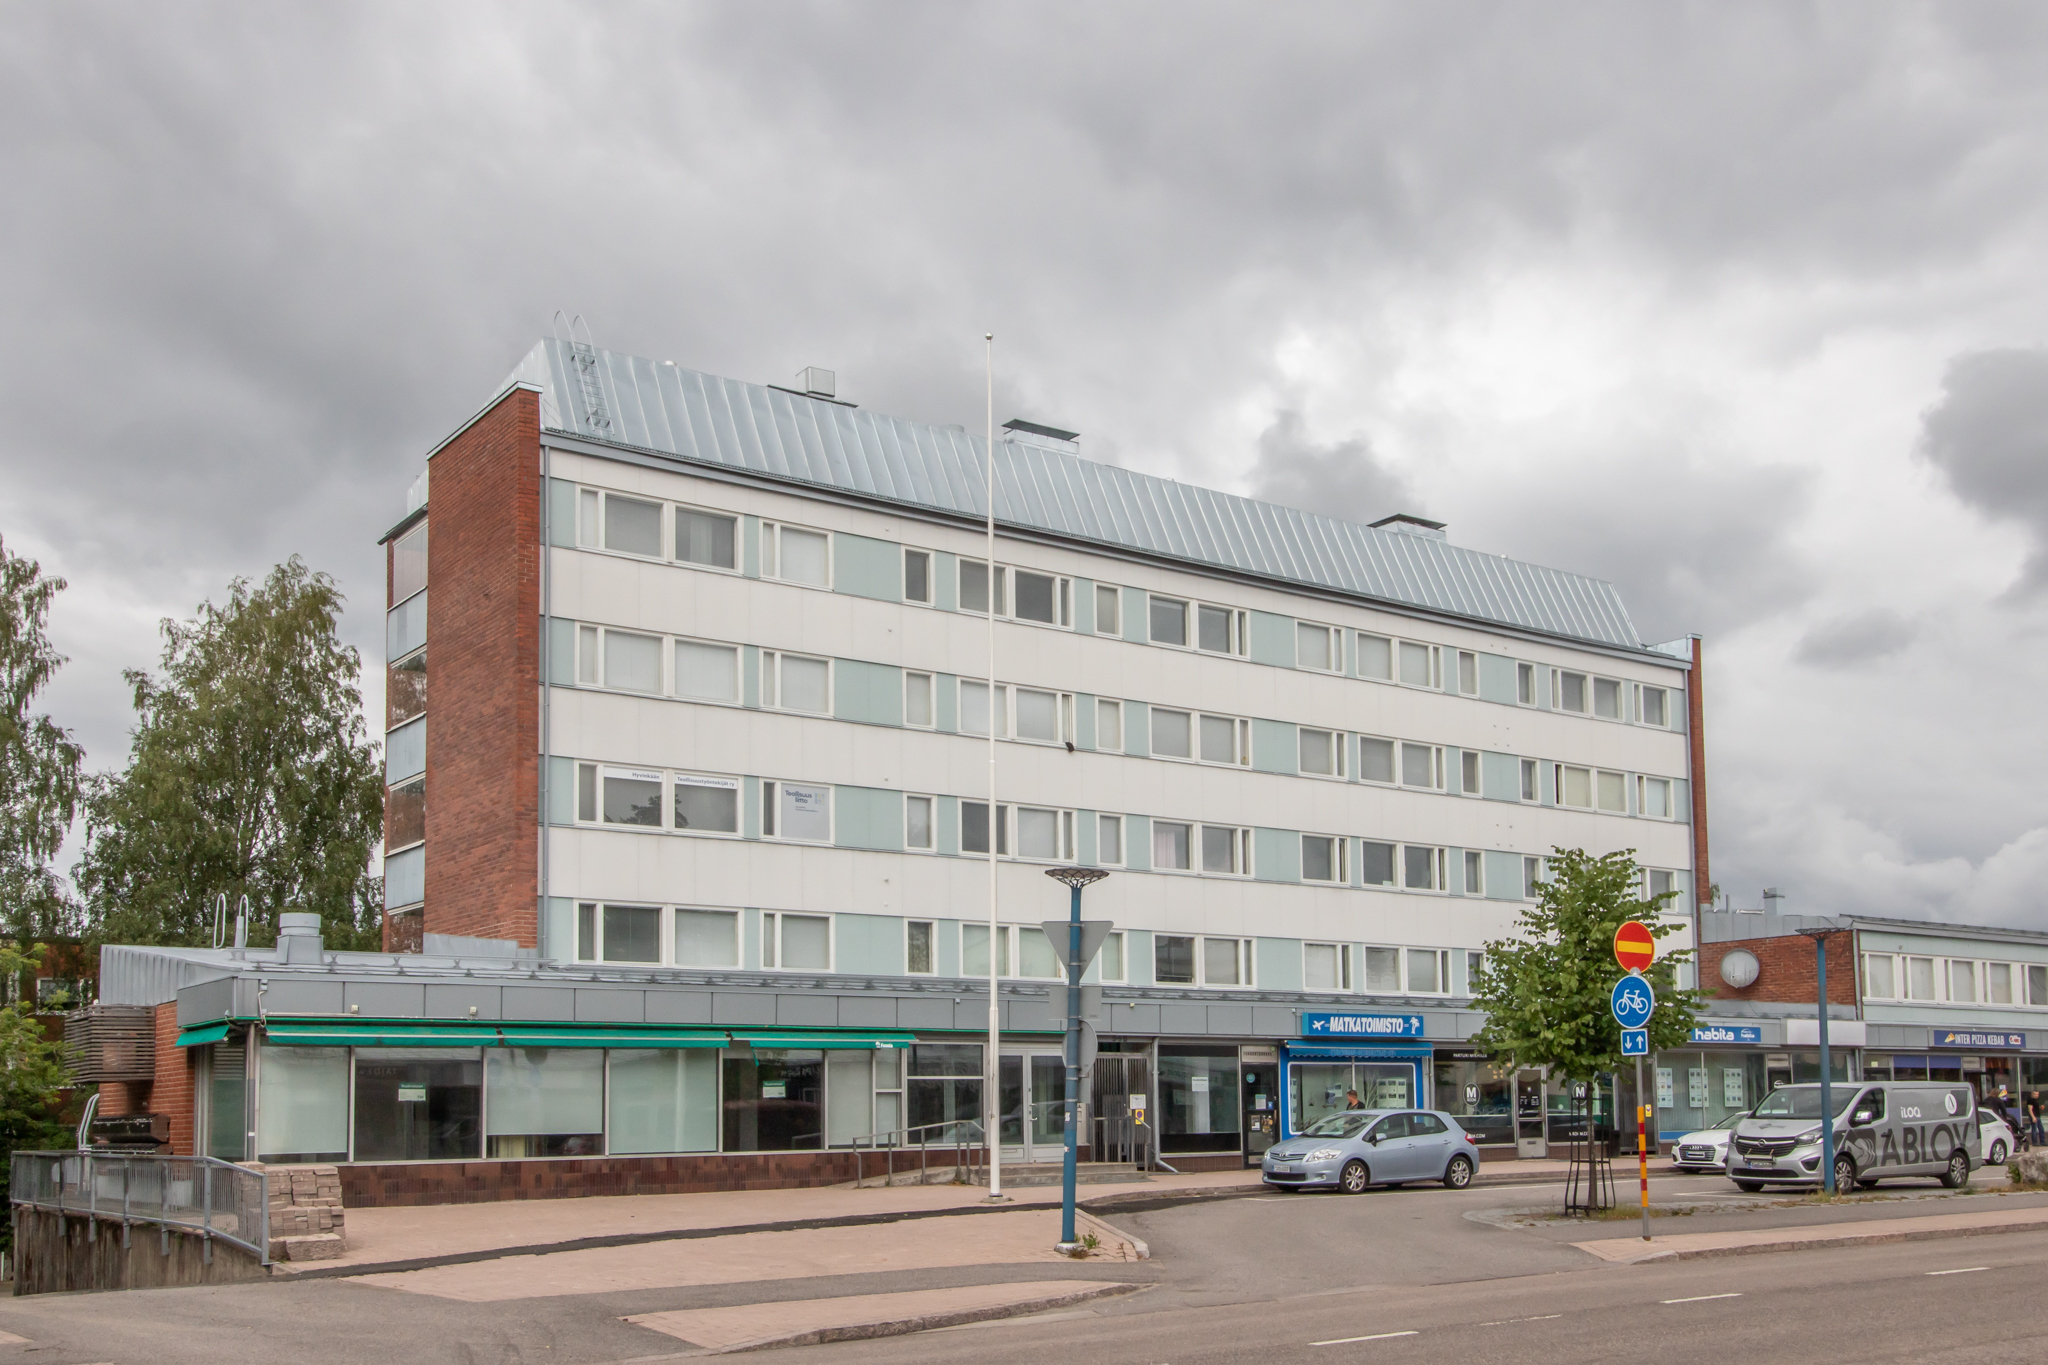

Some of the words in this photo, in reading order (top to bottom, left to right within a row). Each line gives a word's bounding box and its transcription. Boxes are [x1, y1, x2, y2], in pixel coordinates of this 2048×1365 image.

[677, 776, 729, 787] Teollisuustyöntekijät
[785, 790, 812, 798] Teollisuus
[795, 796, 808, 804] liitto
[1329, 1016, 1404, 1033] MATKATOIMISTO
[1695, 1027, 1734, 1041] habita
[1955, 1033, 1971, 1044] INTER
[1971, 1034, 1987, 1045] PIZZA
[1987, 1035, 2005, 1046] KEBAB
[1466, 1086, 1477, 1098] M
[1575, 1086, 1585, 1097] M
[1900, 1106, 1921, 1118] iLOQ
[1881, 1122, 1970, 1166] ABLOY
